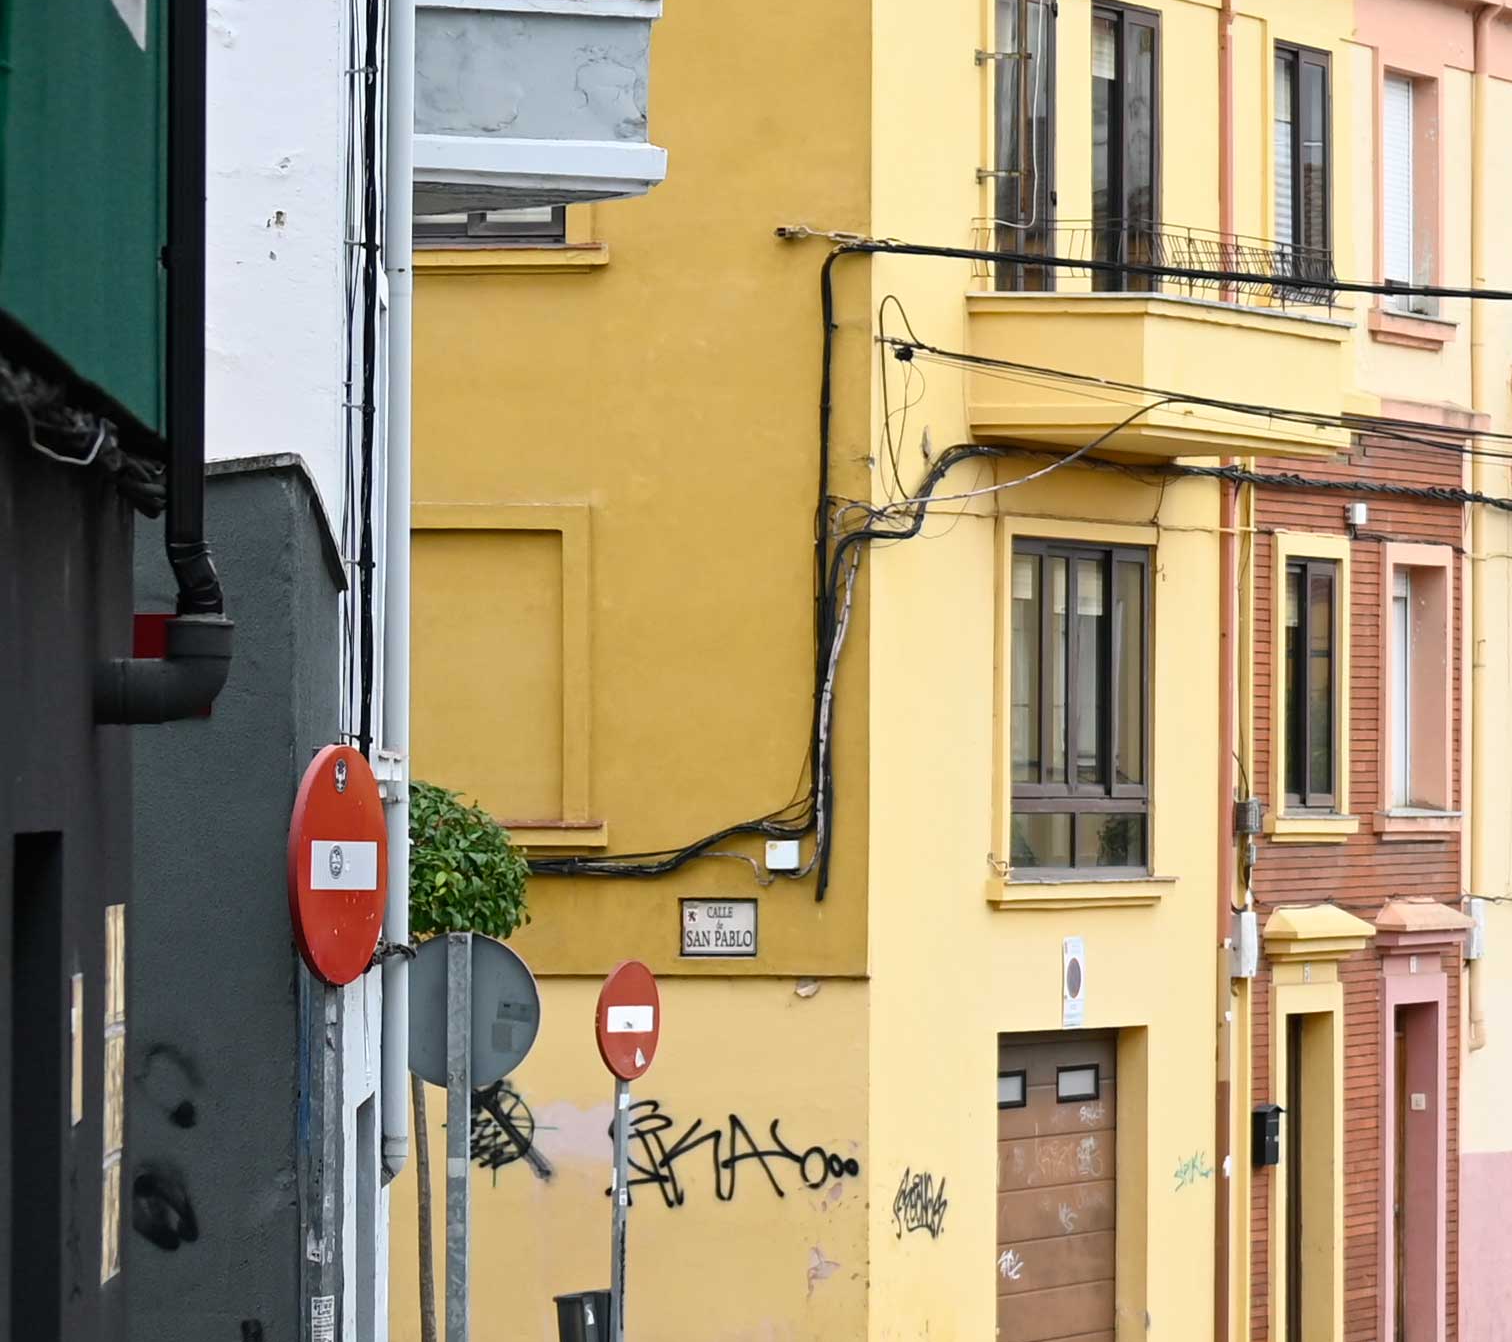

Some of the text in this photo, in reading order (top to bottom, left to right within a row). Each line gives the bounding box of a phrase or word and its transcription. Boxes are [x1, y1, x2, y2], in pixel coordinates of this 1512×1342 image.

[706, 906, 734, 919] CALLE
[686, 929, 753, 947] SAN PABLO
